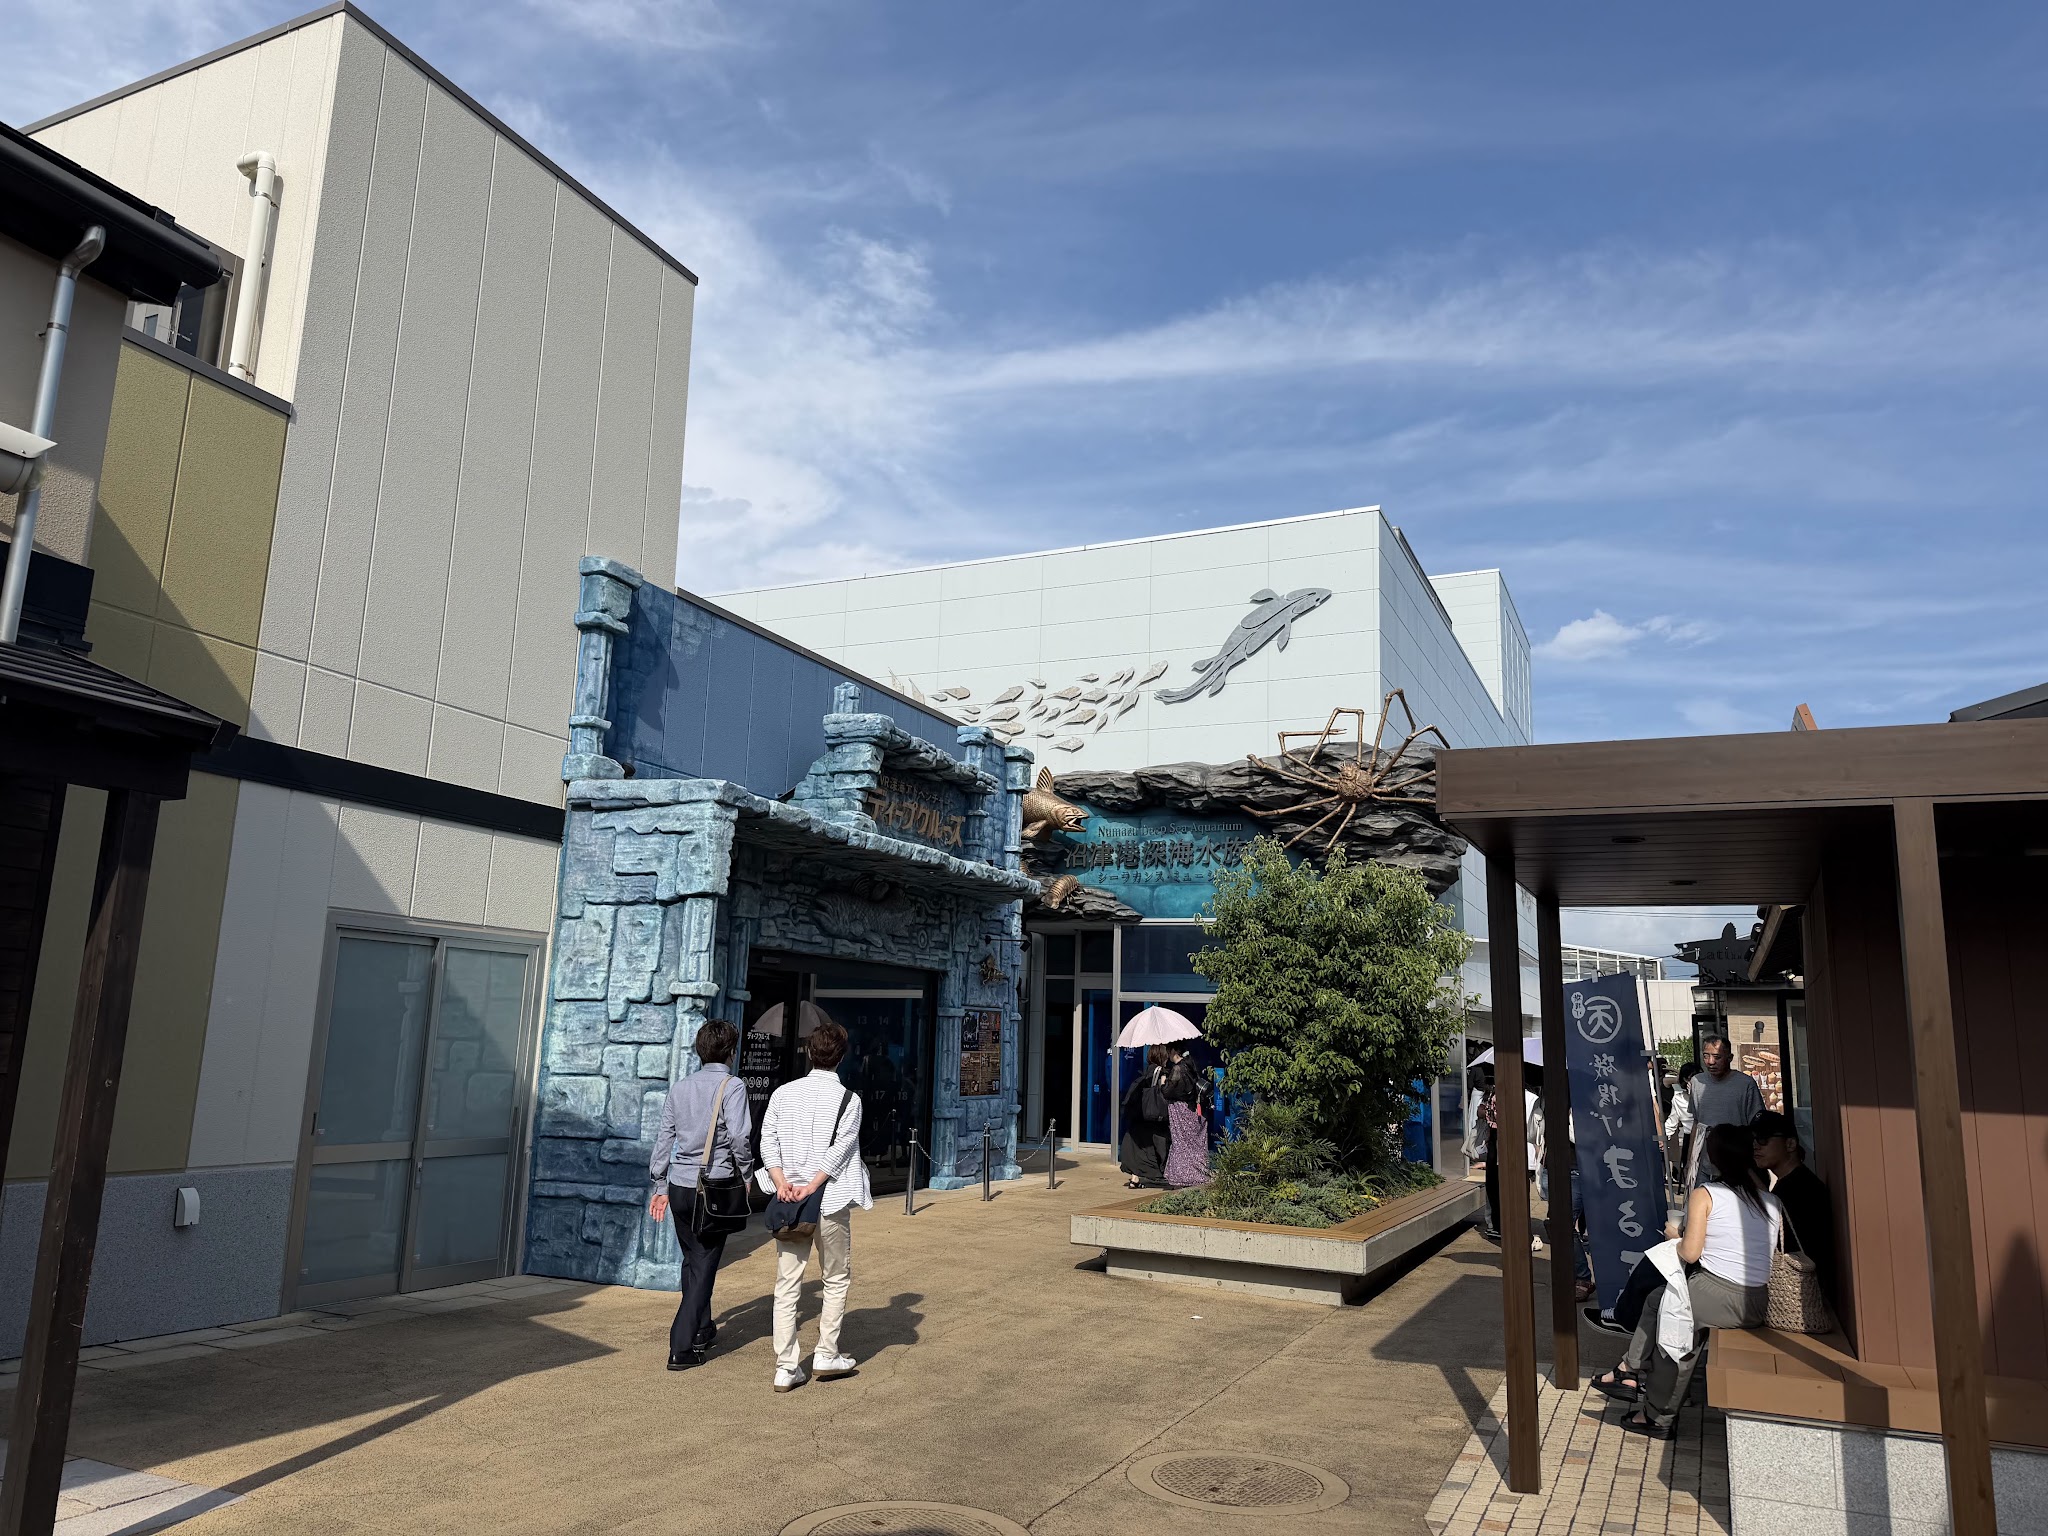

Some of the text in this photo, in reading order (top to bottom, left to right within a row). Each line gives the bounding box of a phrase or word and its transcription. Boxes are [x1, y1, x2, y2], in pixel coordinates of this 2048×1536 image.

[868, 787, 966, 848] ディープクルーズ
[1098, 821, 1243, 838] Numazu Deep Sea Aquarium
[1064, 836, 1262, 869] 沼津港深海水族
